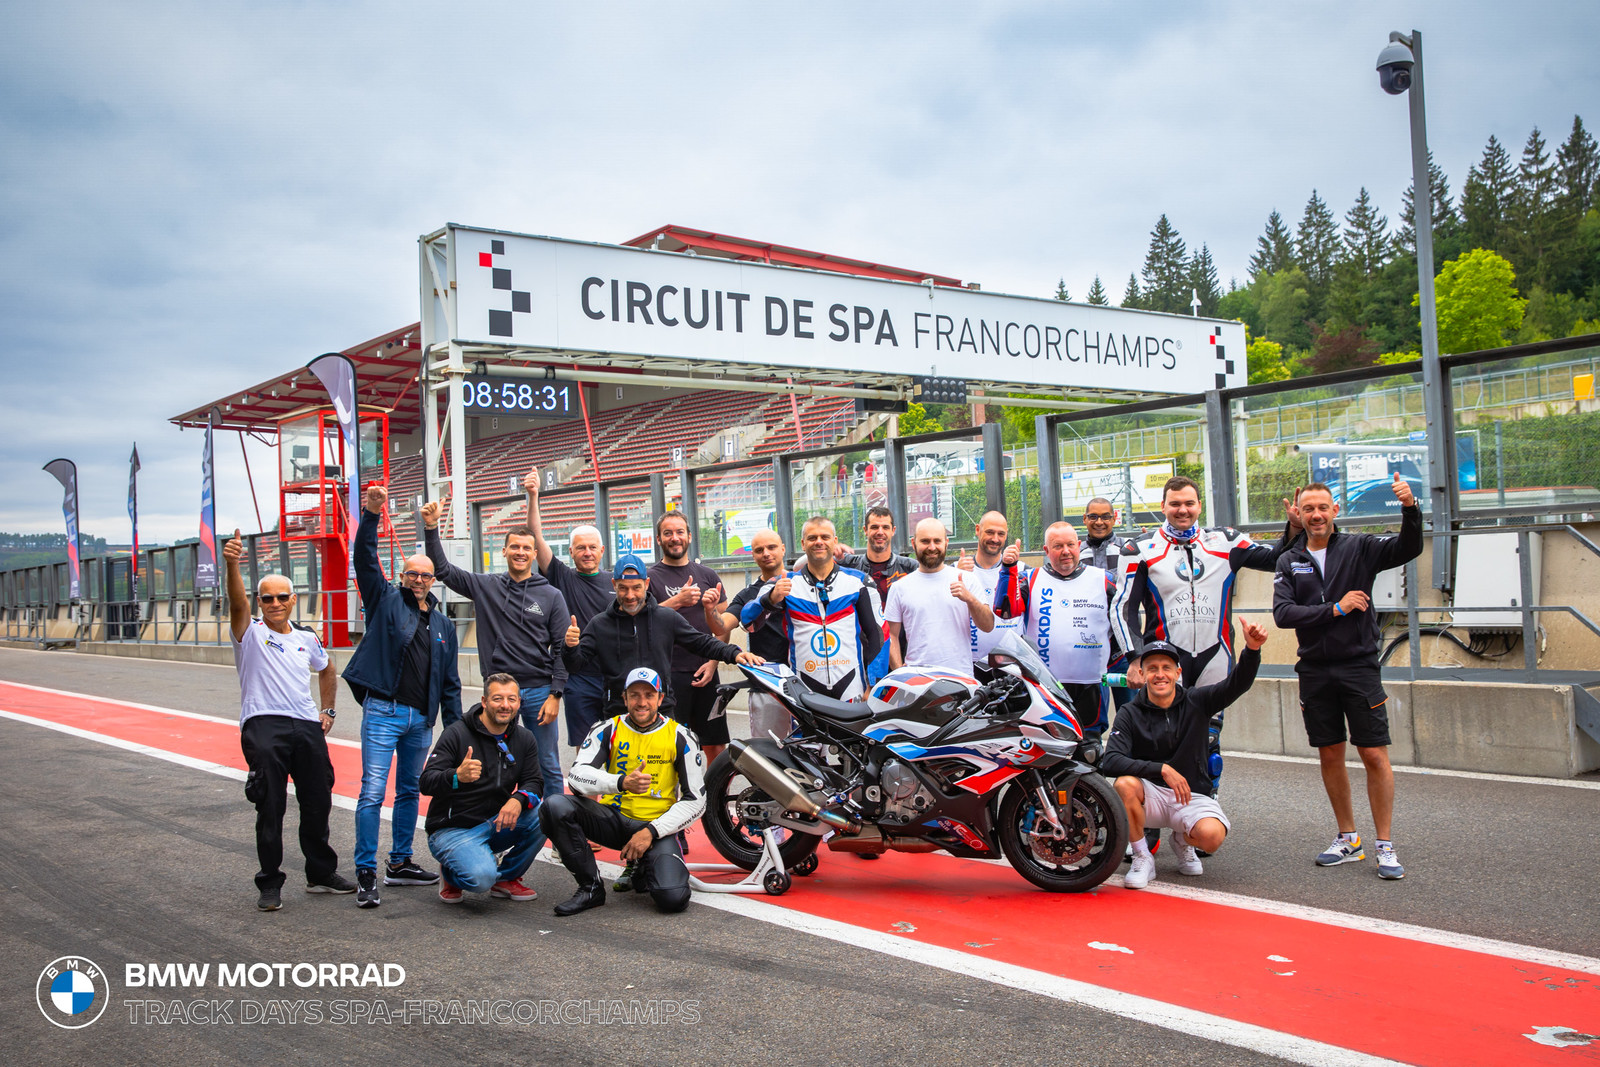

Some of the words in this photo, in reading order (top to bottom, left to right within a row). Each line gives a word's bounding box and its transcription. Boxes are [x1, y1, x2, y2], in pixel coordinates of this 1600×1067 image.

[581, 276, 751, 333] CIRCUIT
[764, 295, 815, 340] DE
[828, 303, 900, 347] SPA
[463, 381, 569, 411] 08:58:31
[618, 533, 652, 551] BigMat
[1170, 606, 1215, 618] EVASION
[574, 774, 597, 785] Motorrad
